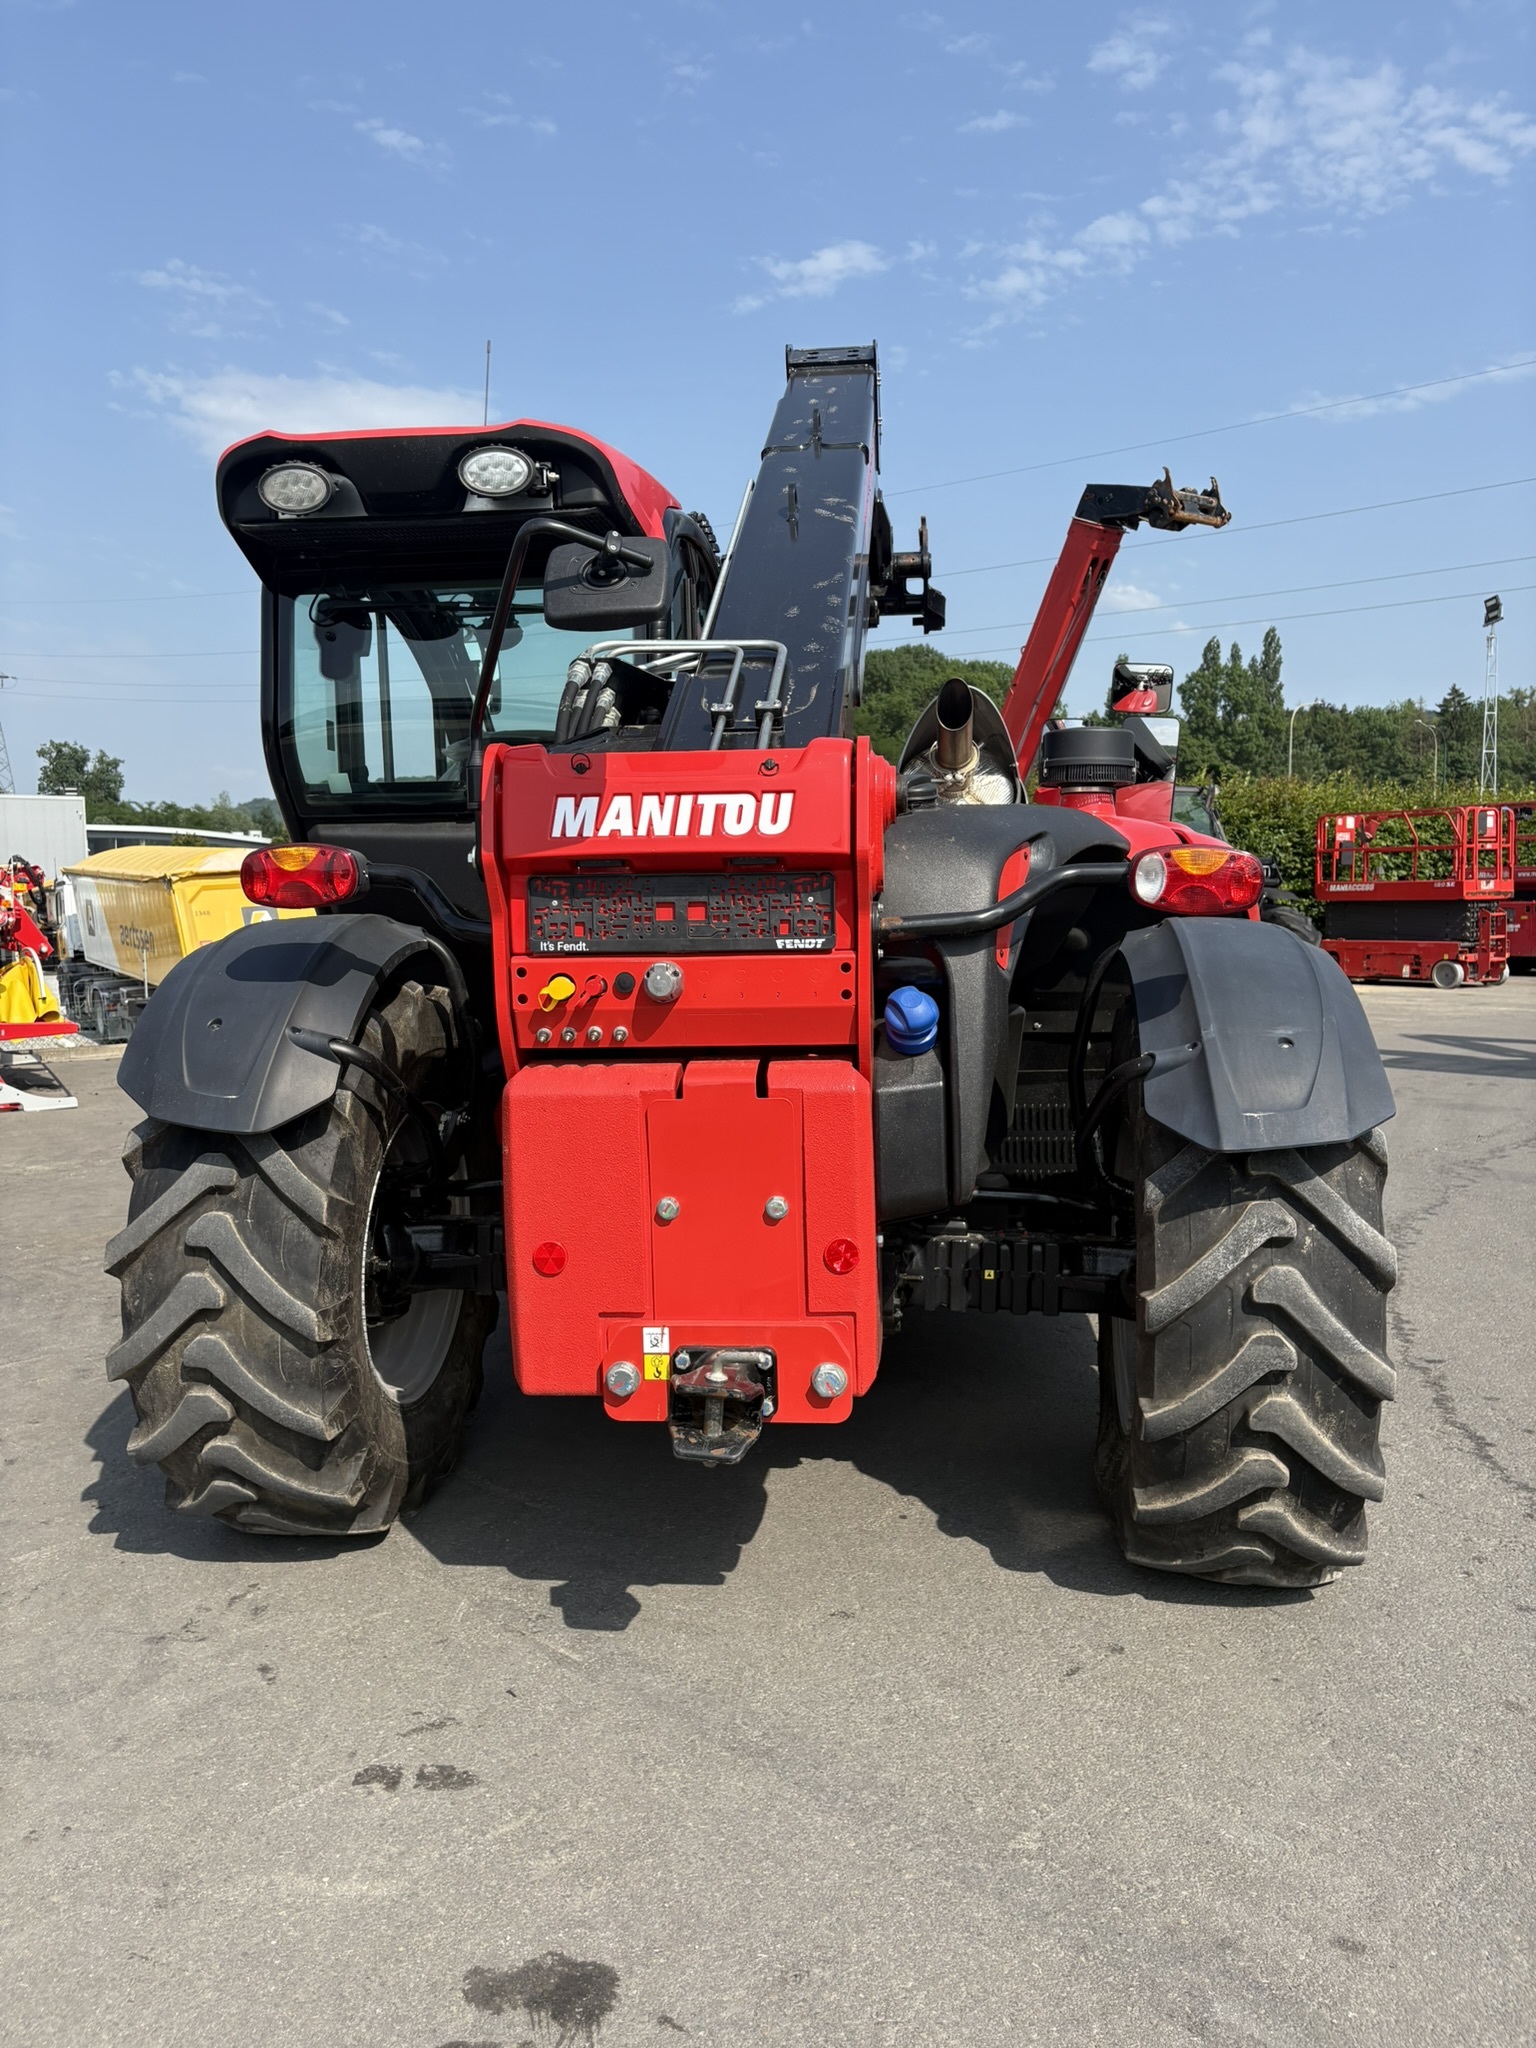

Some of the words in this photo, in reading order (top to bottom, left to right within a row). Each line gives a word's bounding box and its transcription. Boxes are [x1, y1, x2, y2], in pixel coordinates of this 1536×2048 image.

[551, 792, 795, 838] MANITOU
[1329, 883, 1375, 892] MANIACCESS
[119, 921, 155, 954] aertssen
[540, 941, 555, 951] It’s
[557, 941, 589, 951] Fendt.
[775, 938, 826, 949] FENDT
